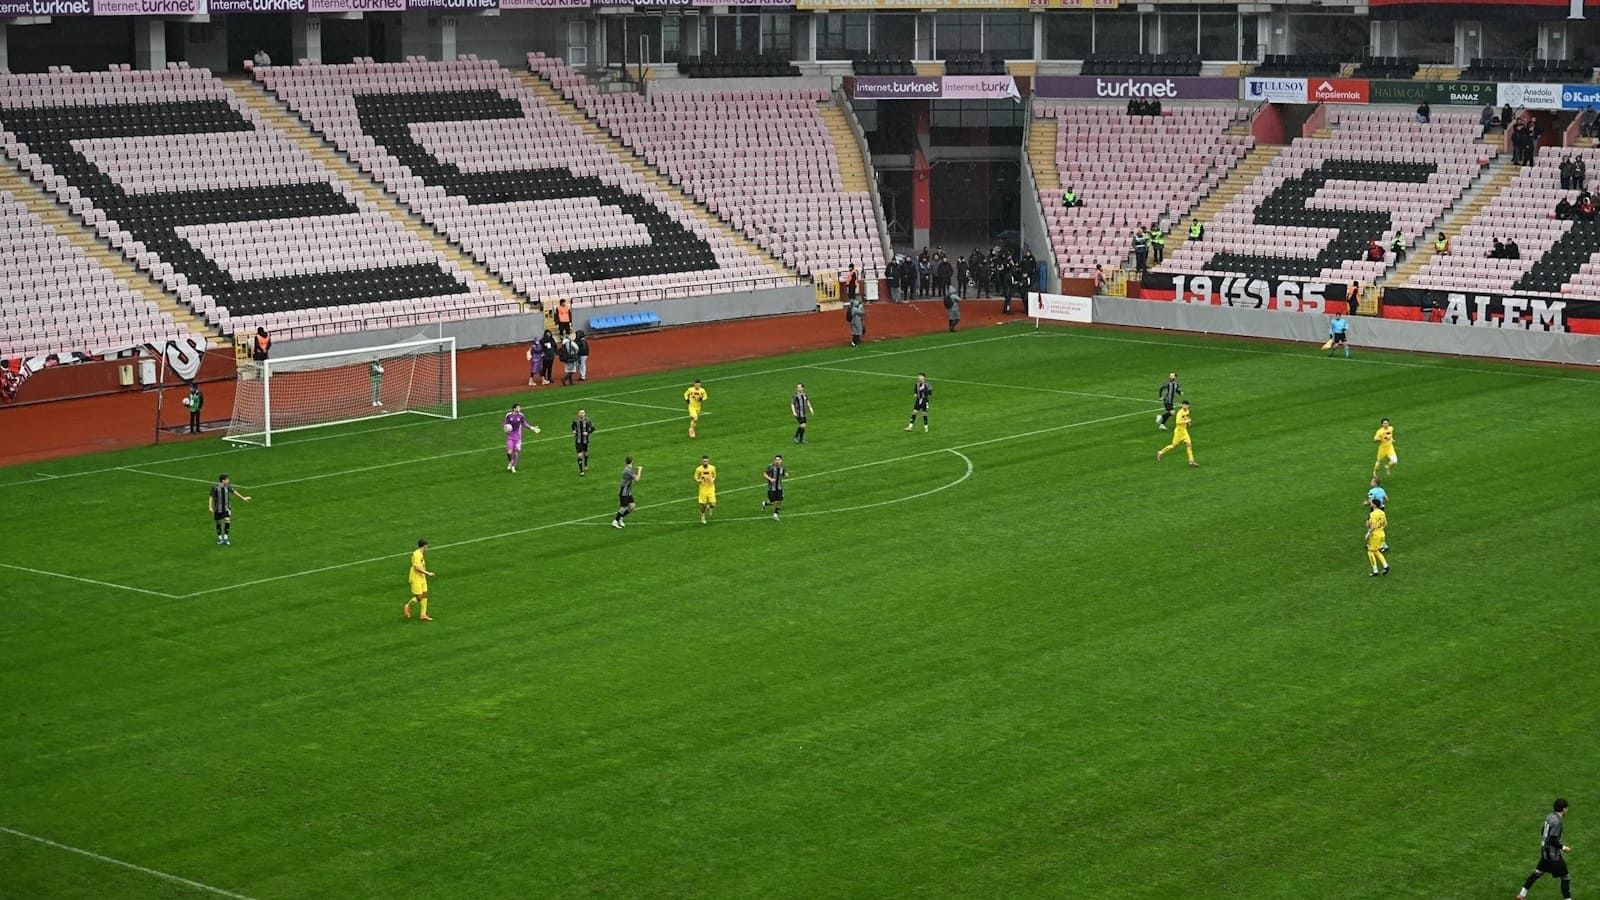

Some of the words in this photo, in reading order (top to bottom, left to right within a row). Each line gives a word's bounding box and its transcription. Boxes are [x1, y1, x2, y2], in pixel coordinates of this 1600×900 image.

[893, 81, 939, 92] turknet
[1096, 78, 1177, 97] turknet
[1264, 81, 1304, 91] ULUSOY
[1315, 90, 1361, 100] hepsiemlak
[1450, 93, 1479, 101] BANAZ
[1523, 87, 1552, 97] Anadolu
[1172, 275, 1213, 305] 19
[1276, 281, 1326, 313] 65
[1442, 293, 1567, 333] ALEM
